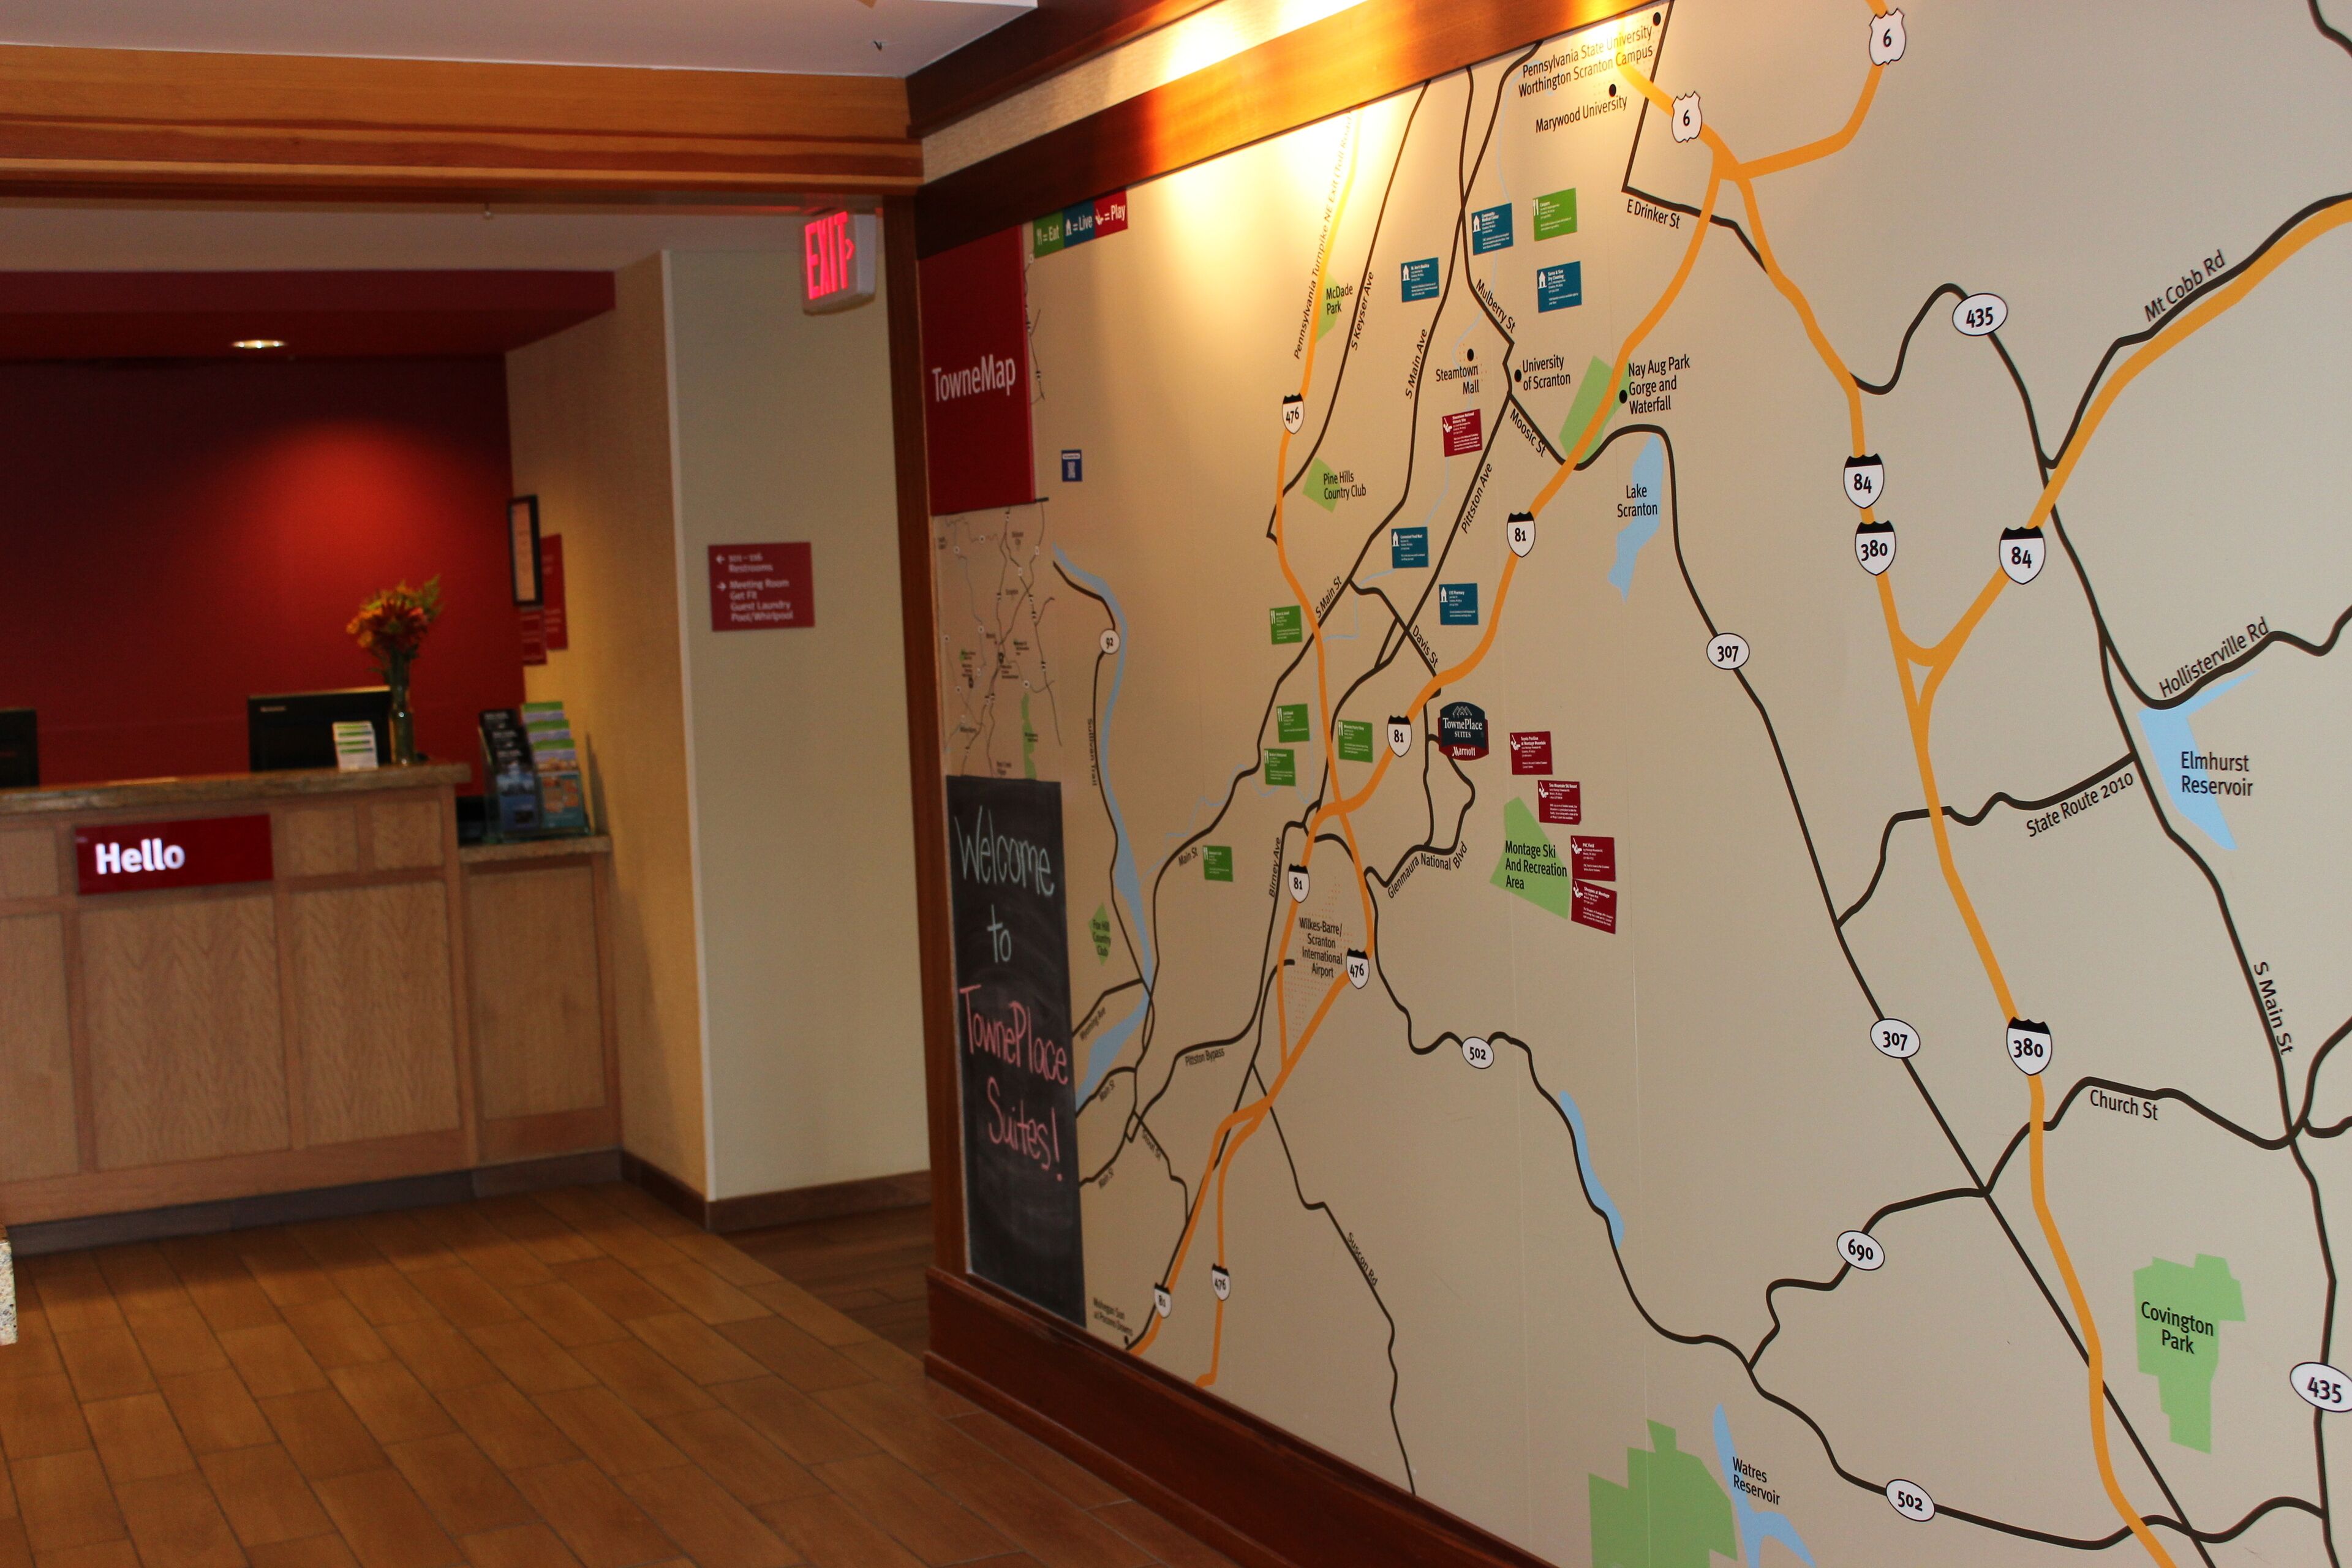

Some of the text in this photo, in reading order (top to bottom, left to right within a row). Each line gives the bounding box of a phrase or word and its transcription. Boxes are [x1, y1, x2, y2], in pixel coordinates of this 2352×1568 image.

[1882, 29, 1892, 48] 6
[1523, 24, 1653, 78] Pennsylvania State University
[1518, 44, 1653, 97] Worthington Scranton Campus
[1536, 96, 1627, 134] Marywood University
[1683, 110, 1690, 126] 6
[1079, 214, 1093, 231] Live
[1110, 205, 1126, 221] Play
[1627, 199, 1680, 229] E Drinker St
[1049, 225, 1060, 241] Eat
[805, 211, 848, 300] EXIT
[1294, 281, 1317, 360] Pennsylvania
[1312, 225, 1329, 277] Turnpike
[1326, 284, 1353, 300] McDade
[2144, 250, 2226, 323] Mt Cobb Rd
[1326, 301, 1342, 315] Park
[1351, 272, 1374, 351] S Keyser Ave
[1476, 279, 1515, 333] Mulberry St
[1966, 305, 1994, 328] 435
[1405, 329, 1428, 399] S Main Ave
[1436, 365, 1479, 382] Steamtown
[1523, 355, 1564, 373] University
[1628, 354, 1690, 377] Nay Aug Park
[932, 355, 1016, 402] TowneMap
[1462, 379, 1480, 395] Mall
[1523, 372, 1570, 391] of Scranton
[1629, 376, 1677, 396] Gorge and
[1286, 406, 1300, 424] 476
[1629, 396, 1672, 414] Waterfall
[1510, 409, 1546, 458] Moosic St
[1324, 471, 1354, 485] Pine Hills
[1853, 473, 1872, 494] 84
[1324, 485, 1366, 500] Country Club
[1461, 463, 1493, 534] Pittston Ave
[1626, 484, 1647, 498] Lake
[1617, 503, 1658, 518] Scranton
[1514, 528, 1526, 542] 81
[1861, 539, 1888, 560] 380
[2011, 547, 2032, 568] 84
[728, 564, 774, 573] Restrooms
[729, 579, 790, 590] Meeting Room
[729, 590, 757, 601] Get Fit
[1315, 576, 1342, 619] S Main St
[730, 601, 791, 611] Guest Laundry
[730, 611, 794, 624] Pool/Whirlpool
[1106, 638, 1114, 649] 92
[1412, 625, 1439, 668] Davis St
[1717, 646, 1739, 662] 307
[2158, 617, 2270, 698] Hollisterville Rd
[1442, 717, 1483, 731] TownePlace
[1393, 729, 1404, 744] 81
[1454, 730, 1471, 739] SUITES
[1452, 745, 1476, 757] Marriott
[2180, 752, 2249, 772] Elmhurst
[2180, 775, 2253, 796] Reservoir
[2025, 774, 2134, 838] State Route 2010
[96, 839, 185, 875] Hello
[954, 805, 1055, 897] Welcome
[1178, 850, 1192, 867] Main
[1192, 846, 1199, 859] St
[1505, 841, 1556, 859] Montage Ski
[1387, 841, 1468, 899] Glenmaura National Blvd
[1506, 858, 1522, 872] And
[1523, 860, 1567, 878] Recreation
[1268, 860, 1279, 898] Birney
[1294, 876, 1303, 890] 81
[1506, 875, 1525, 889] Area
[987, 905, 1011, 963] to
[1299, 917, 1343, 937] Wilkes-Barre/
[1308, 933, 1336, 949] Scranton
[1302, 946, 1343, 965] International
[1312, 963, 1334, 978] Airport
[1349, 963, 1365, 978] 476
[2254, 960, 2293, 1056] S Main St
[960, 984, 1068, 1085] TownePlace
[1882, 1031, 1908, 1051] 307
[1185, 1047, 1224, 1066] Pittston Bypass
[1470, 1046, 1487, 1060] 502
[2014, 1038, 2043, 1059] 380
[2089, 1090, 2158, 1122] Church St
[987, 1076, 1063, 1182] Suites!
[1348, 1232, 1378, 1286] Suscon Rd
[1848, 1240, 1874, 1261] 690
[1215, 1278, 1226, 1291] 476
[2141, 1302, 2214, 1337] Covington
[2160, 1330, 2195, 1354] Park
[2307, 1378, 2342, 1403] 435
[1732, 1457, 1768, 1483] Watres
[1733, 1475, 1781, 1506] Reservoir
[1898, 1492, 1923, 1512] 502
